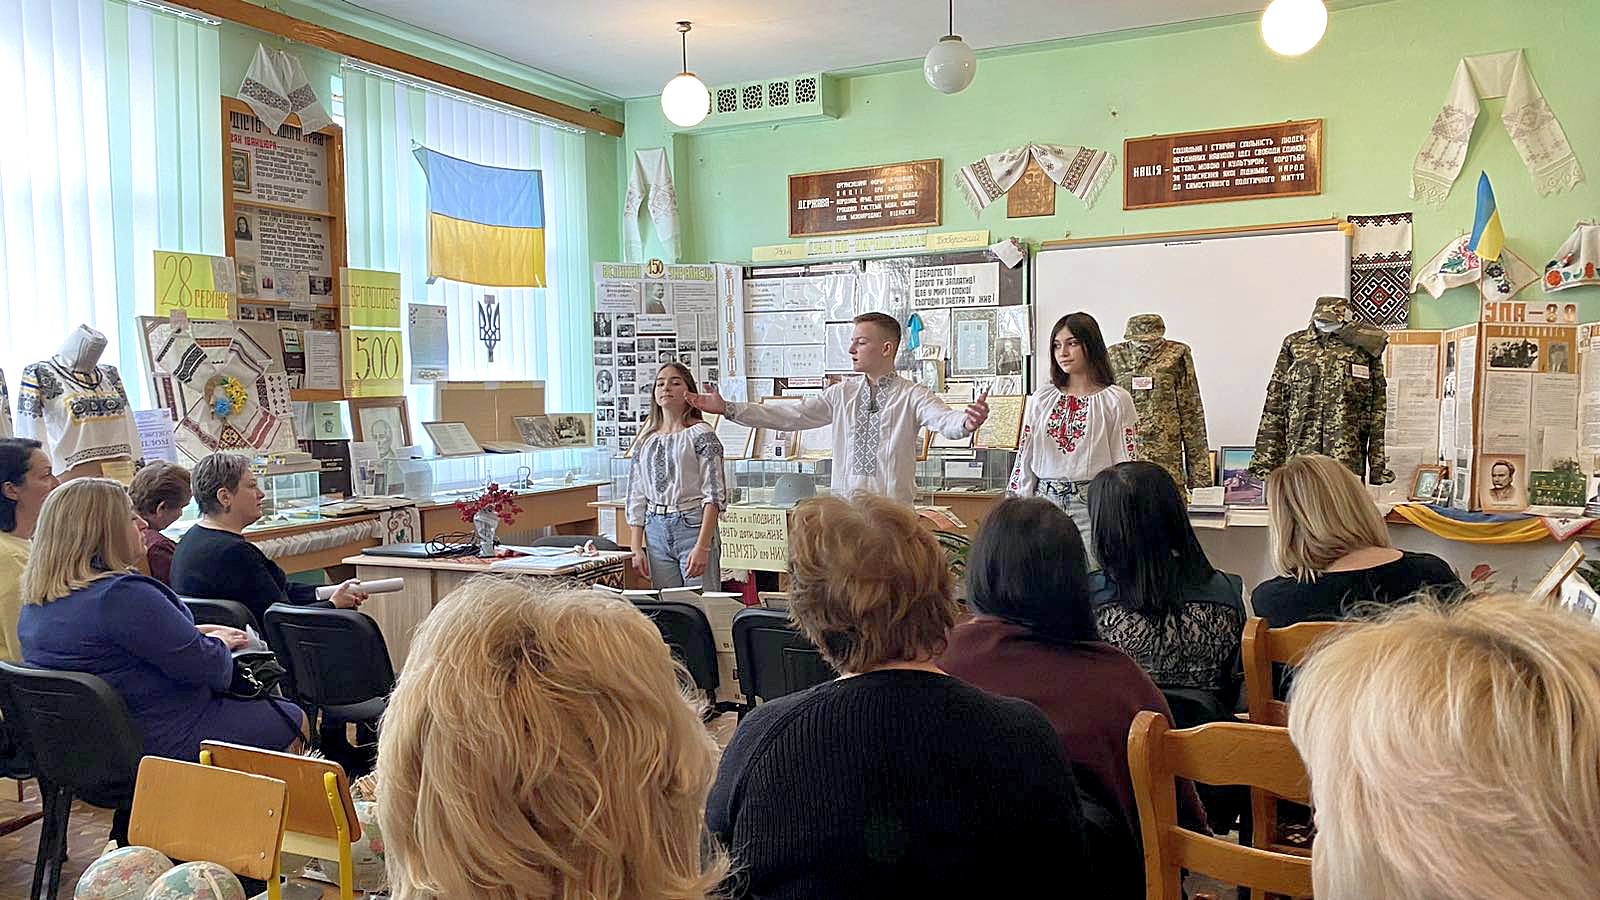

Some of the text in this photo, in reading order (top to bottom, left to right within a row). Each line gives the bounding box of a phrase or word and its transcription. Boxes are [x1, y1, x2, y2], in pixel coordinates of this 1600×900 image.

[1274, 154, 1305, 163] БОРОТЬБА
[1133, 165, 1162, 178] НАЦІЯ
[1279, 163, 1305, 172] НАРОД
[1281, 172, 1305, 182] ЖИТТЯ
[648, 259, 664, 275] 150
[160, 254, 193, 308] 28
[914, 279, 935, 289] ДОРОГО
[936, 278, 944, 287] ТИ
[933, 287, 947, 297] МИРІ
[967, 295, 975, 304] ТИ
[355, 336, 399, 381] 500
[753, 513, 781, 525] ПОДВИГИ
[766, 529, 784, 541] ЖИВЕ
[769, 546, 786, 561] НИХ
